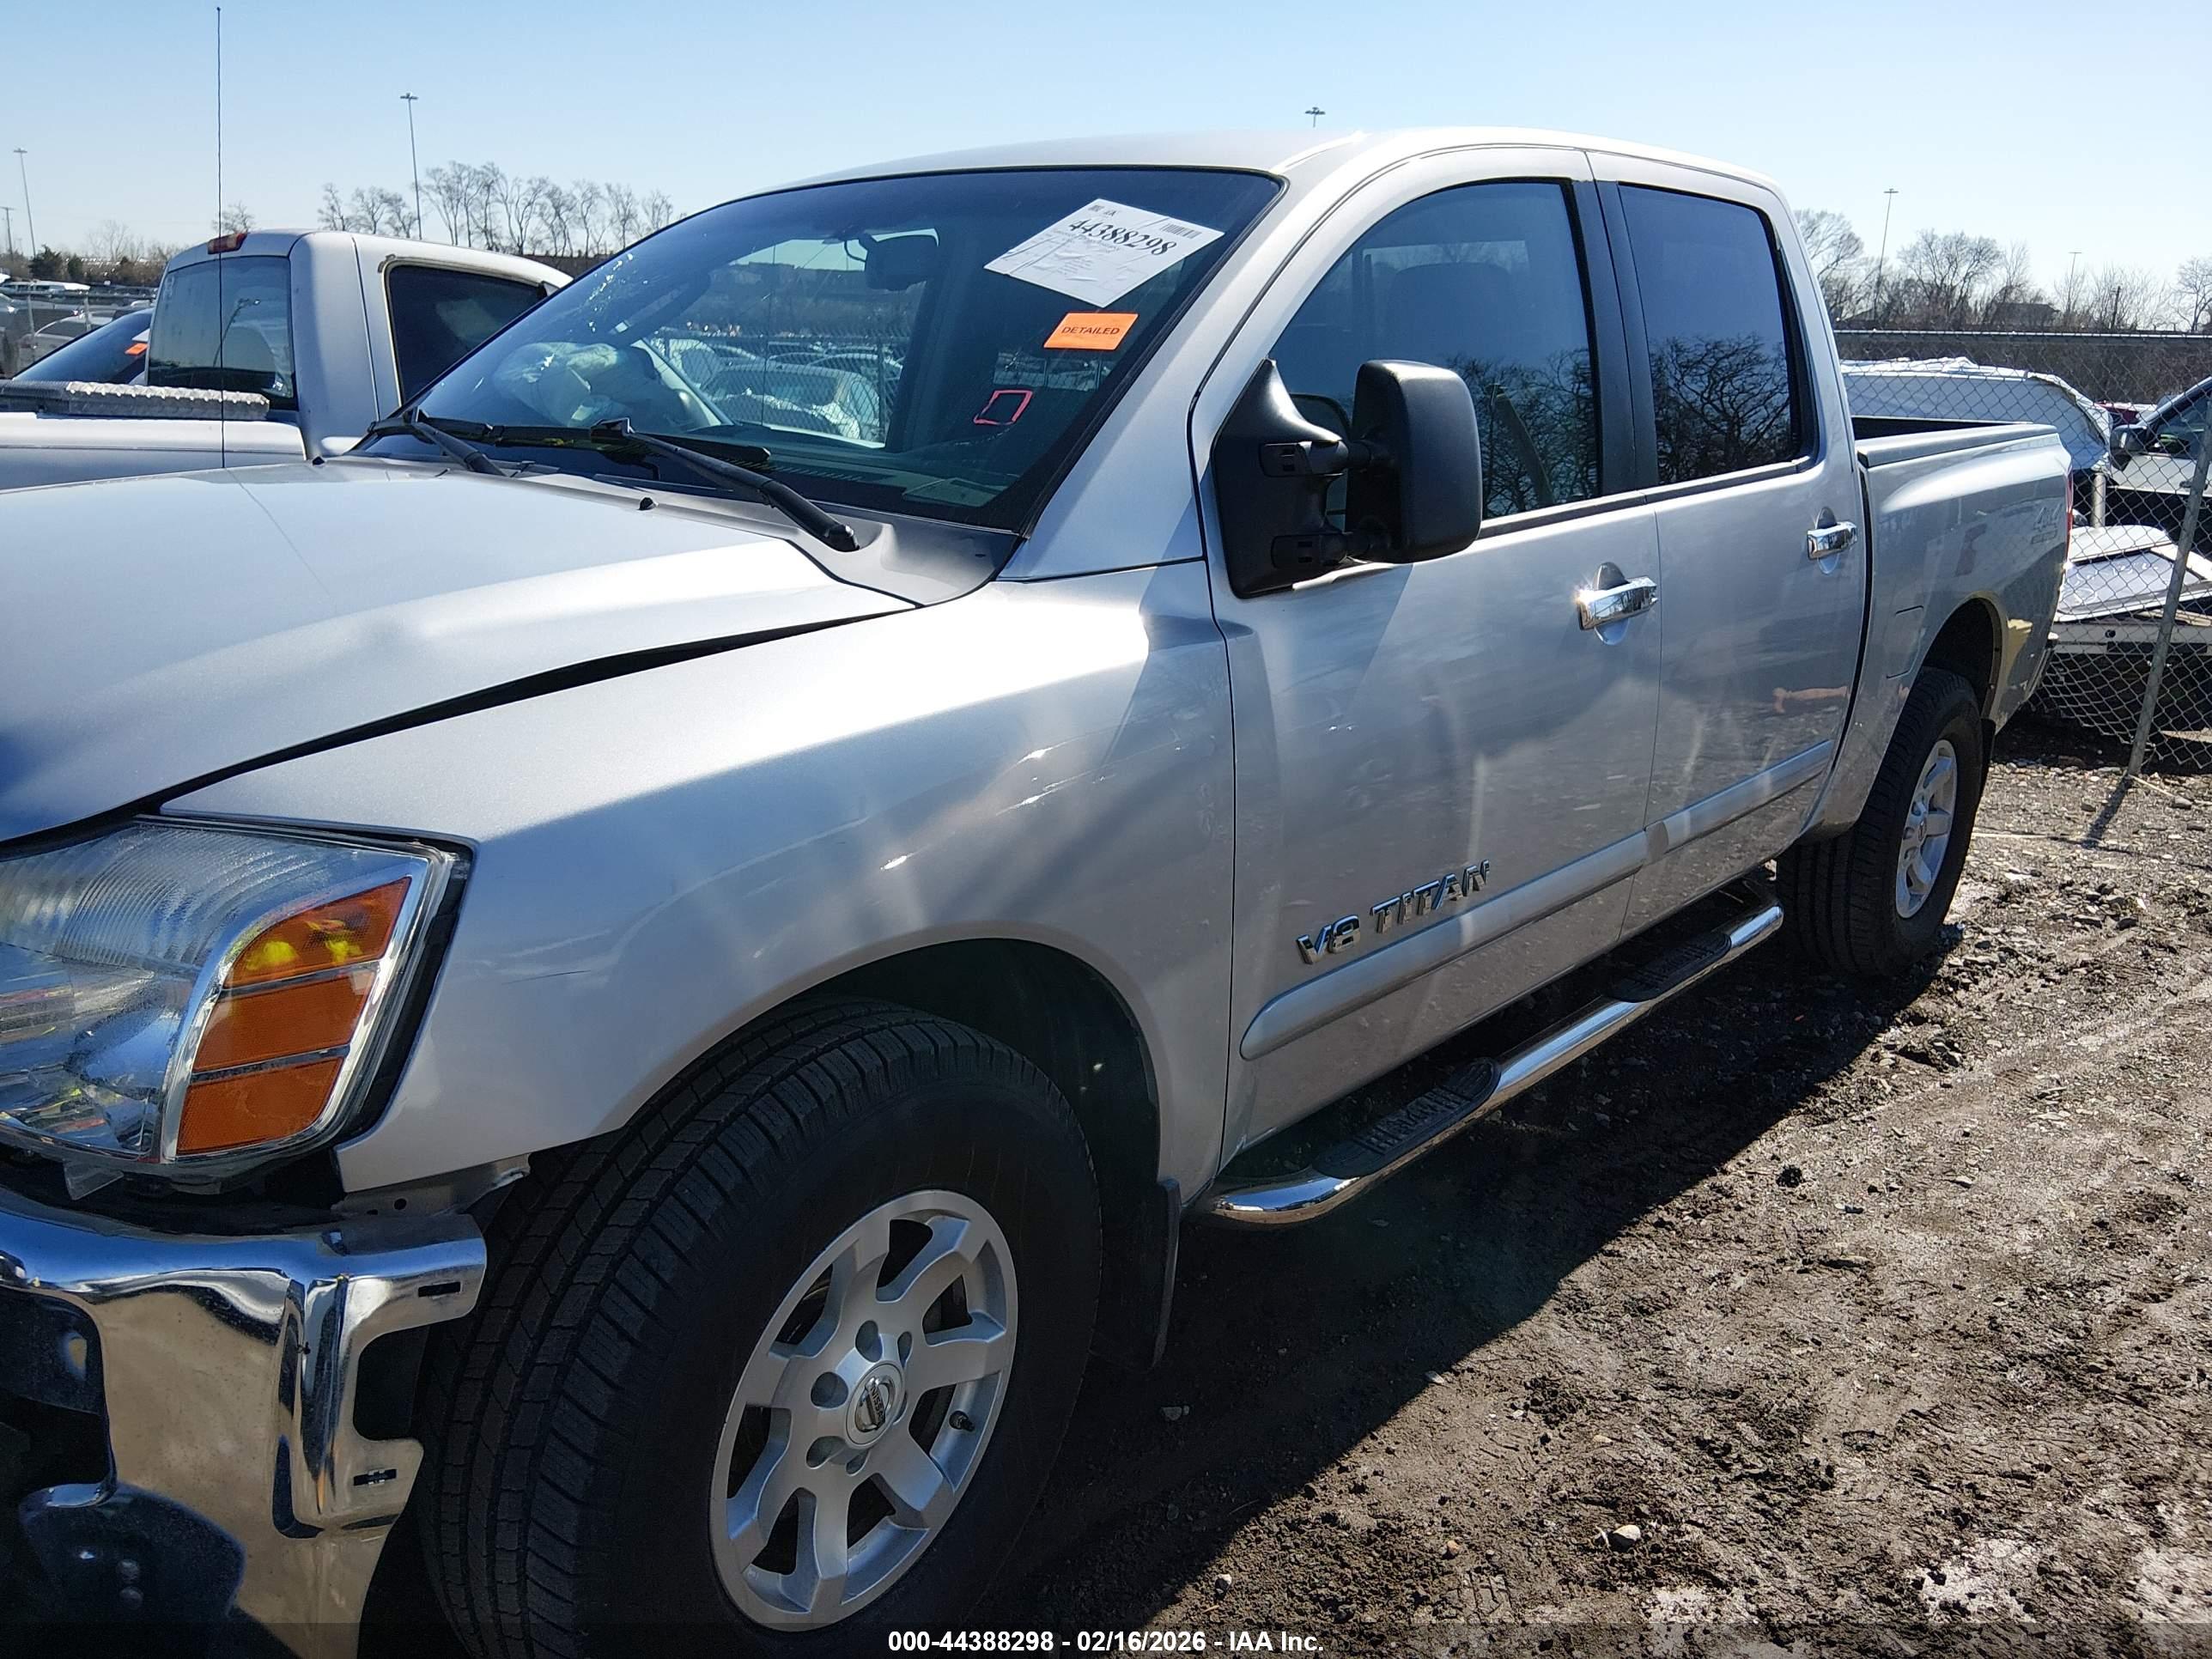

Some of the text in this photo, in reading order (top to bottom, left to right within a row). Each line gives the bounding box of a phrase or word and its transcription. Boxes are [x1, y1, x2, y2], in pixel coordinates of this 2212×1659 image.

[1069, 218, 1177, 256] 44388298
[1061, 326, 1120, 336] DETAILED
[1296, 860, 1490, 964] V8 TITAN
